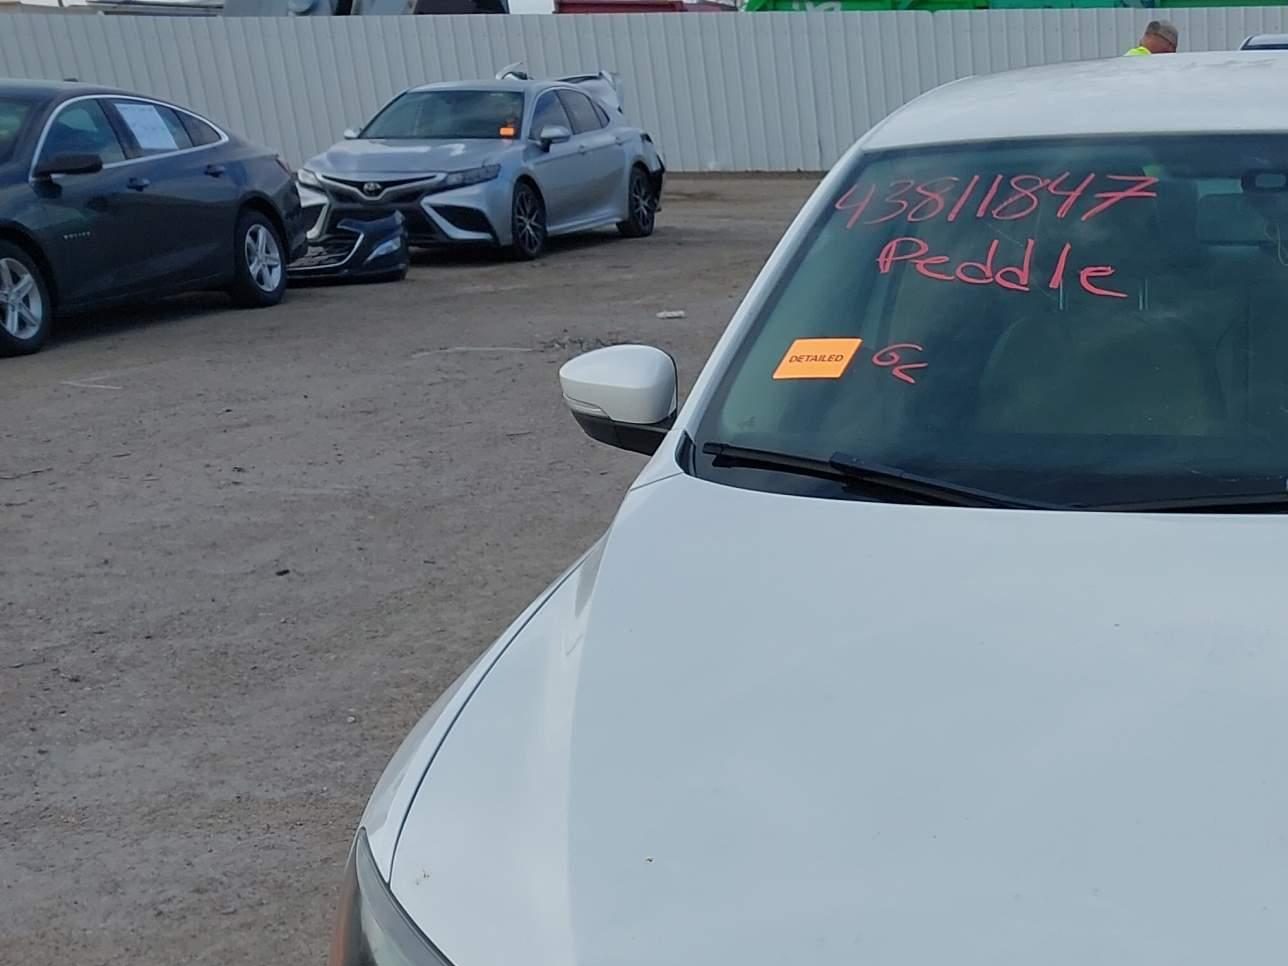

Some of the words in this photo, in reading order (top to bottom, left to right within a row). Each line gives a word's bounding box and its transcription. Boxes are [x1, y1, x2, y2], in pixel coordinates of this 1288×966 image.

[834, 171, 1158, 229] 43811847
[876, 236, 1128, 298] Peddle
[788, 353, 844, 364] DETAILED
